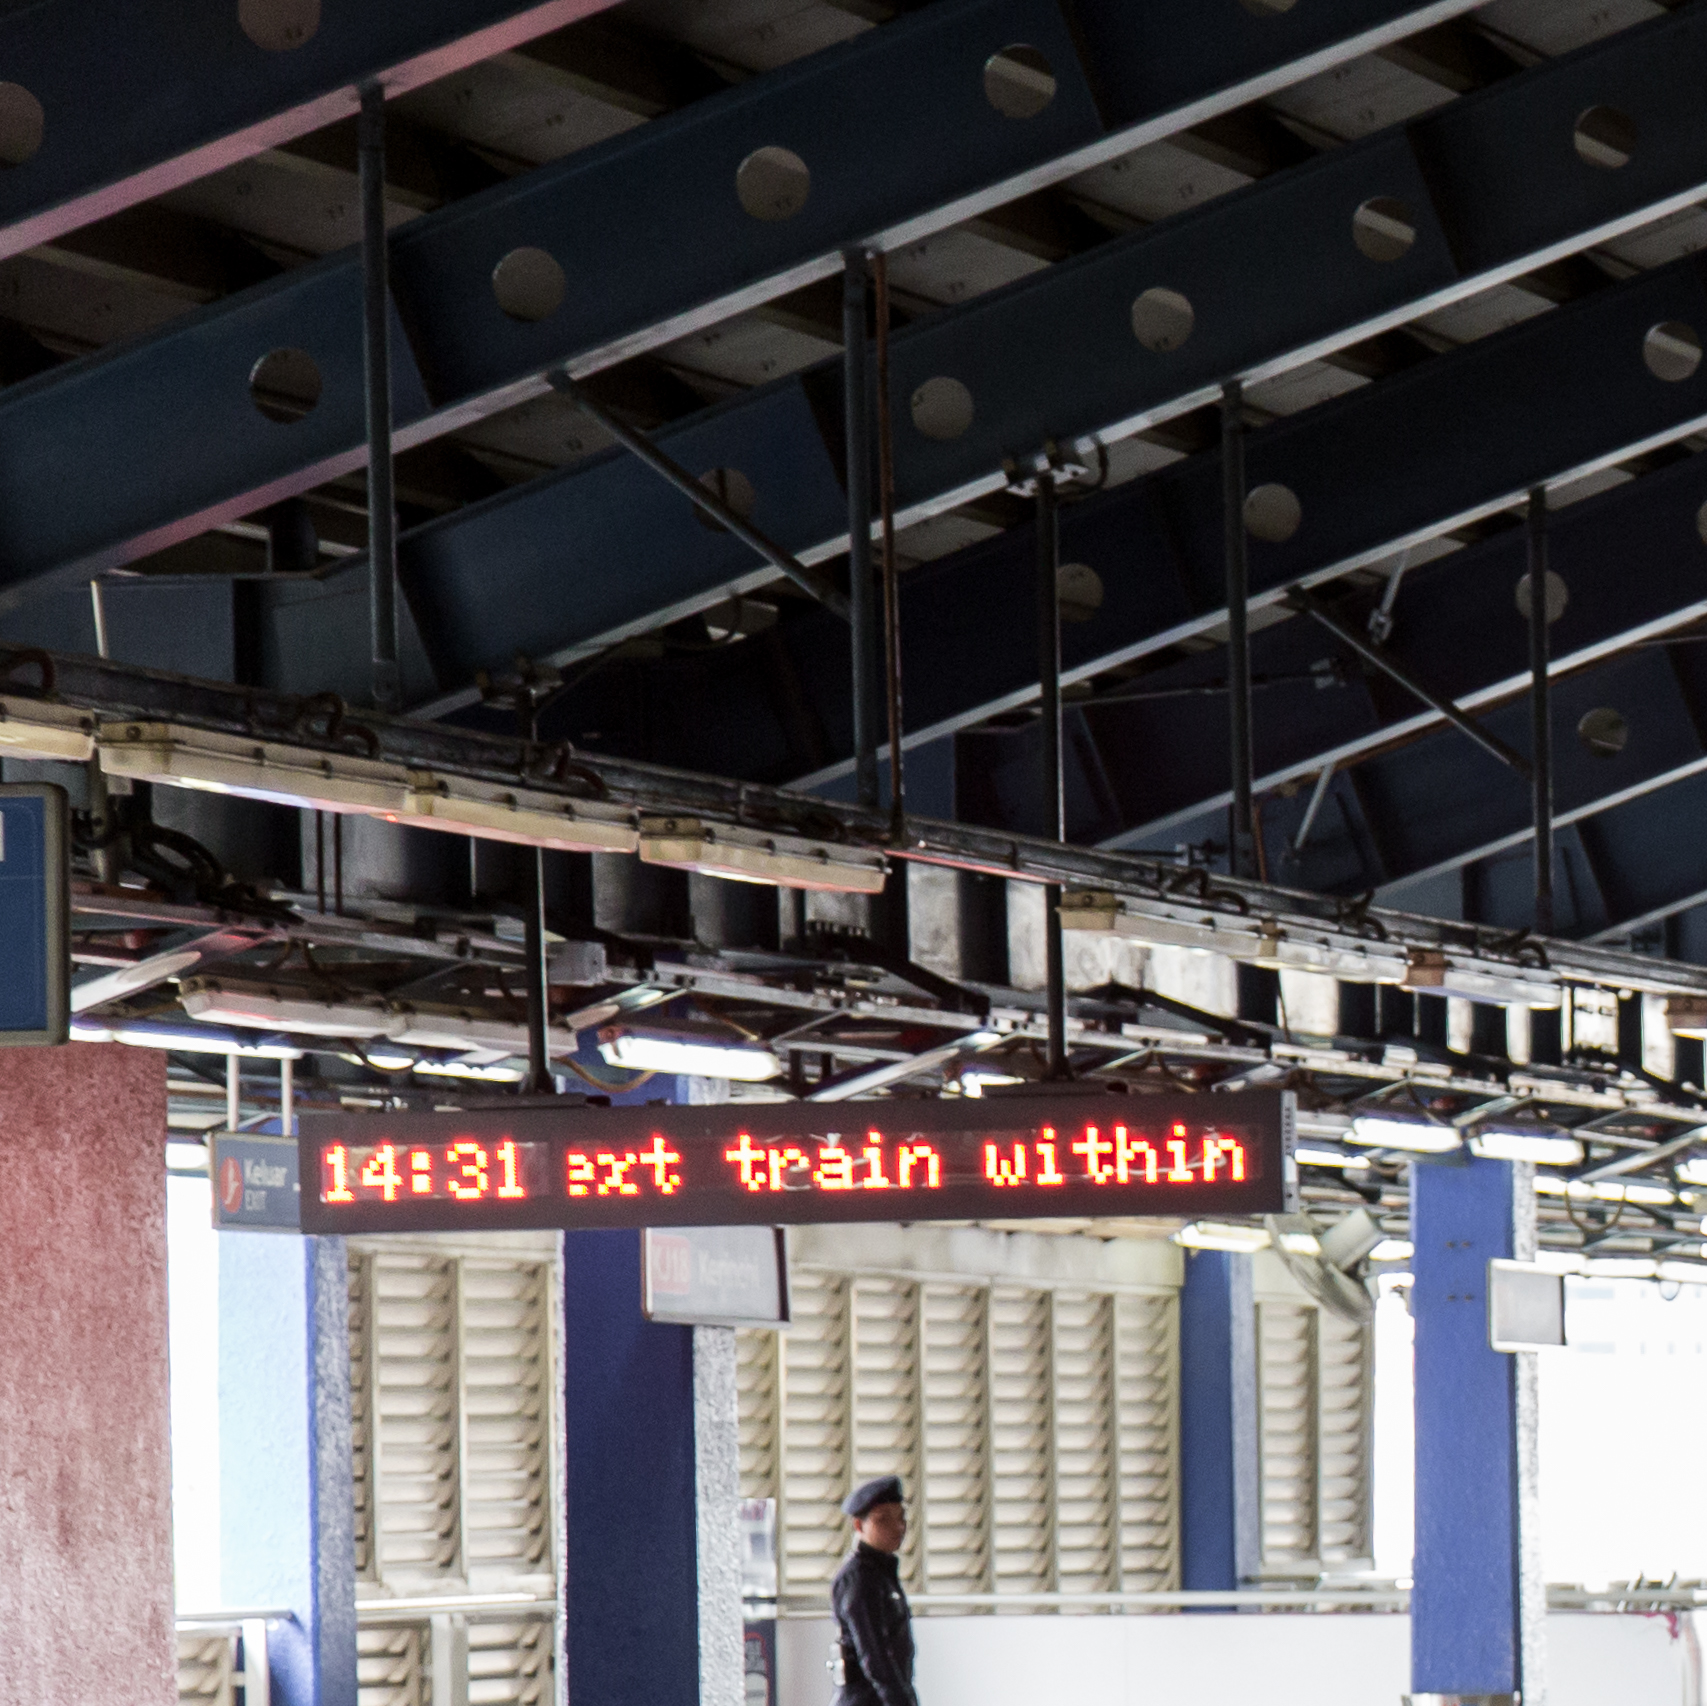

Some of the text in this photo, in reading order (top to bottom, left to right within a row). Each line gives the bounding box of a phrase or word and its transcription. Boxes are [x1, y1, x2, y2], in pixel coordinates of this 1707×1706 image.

[244, 1156, 288, 1188] Keluar
[325, 1122, 1246, 1203] 14:31 ext train within
